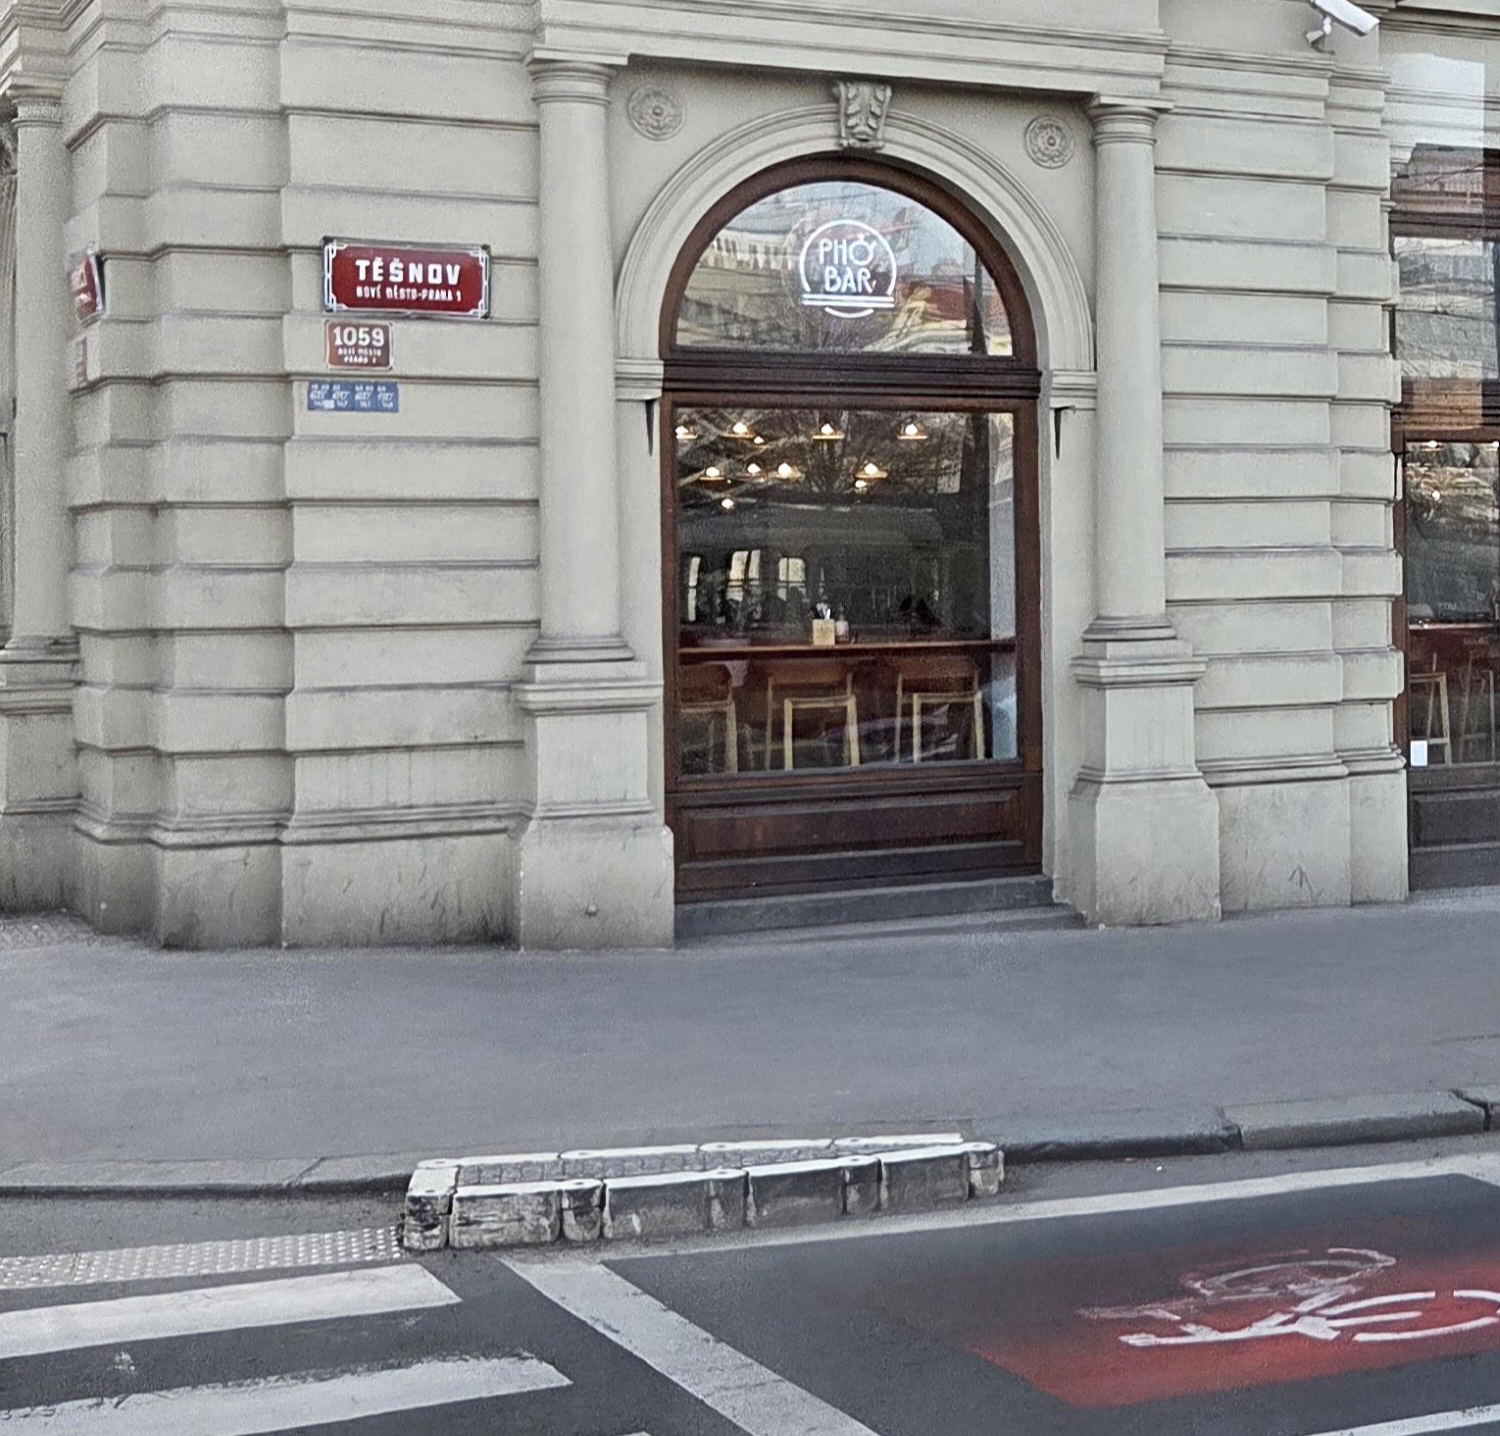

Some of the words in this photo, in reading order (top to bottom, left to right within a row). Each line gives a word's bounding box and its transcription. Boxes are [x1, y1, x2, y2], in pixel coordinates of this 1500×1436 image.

[355, 256, 461, 286] TĚŠNOV
[824, 265, 874, 293] BAR
[456, 289, 462, 302] 1
[333, 326, 385, 347] 1059
